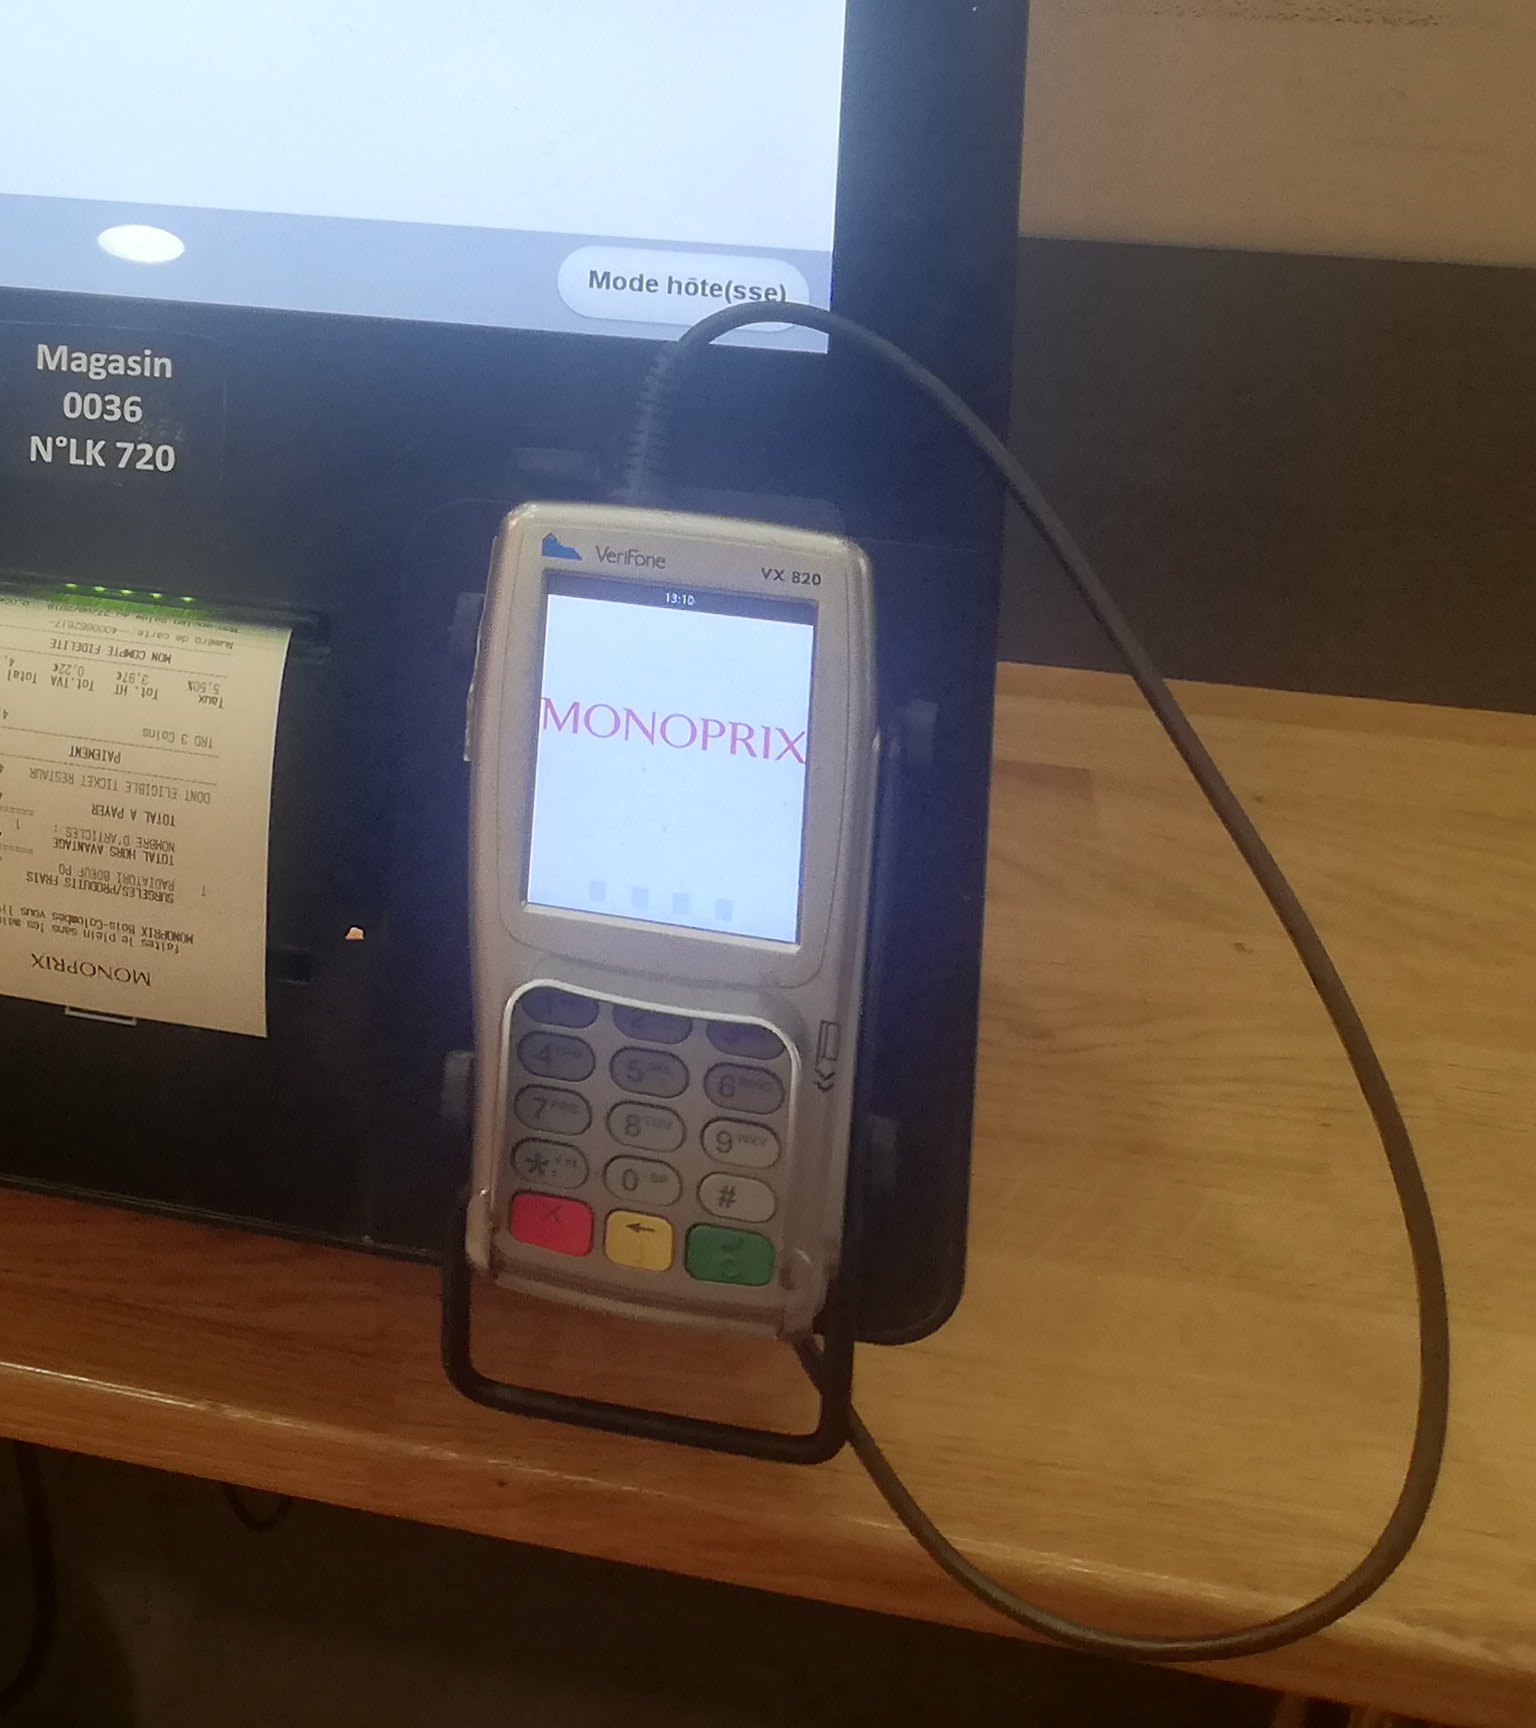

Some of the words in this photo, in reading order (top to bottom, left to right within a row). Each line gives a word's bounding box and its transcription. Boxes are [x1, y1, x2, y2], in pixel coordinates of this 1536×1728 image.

[588, 268, 660, 297] Mode
[35, 342, 174, 380] Magasin
[62, 390, 144, 424] 0036
[29, 434, 106, 470] N°LK
[115, 439, 176, 474] 720
[594, 543, 667, 571] VeriFone
[760, 566, 788, 586] VX
[790, 568, 823, 588] 820
[540, 695, 809, 767] MONOPRIX
[91, 801, 126, 820] PAYER
[129, 807, 138, 821] A
[145, 810, 177, 827] TOTAL
[30, 951, 153, 988] MONOPRIX
